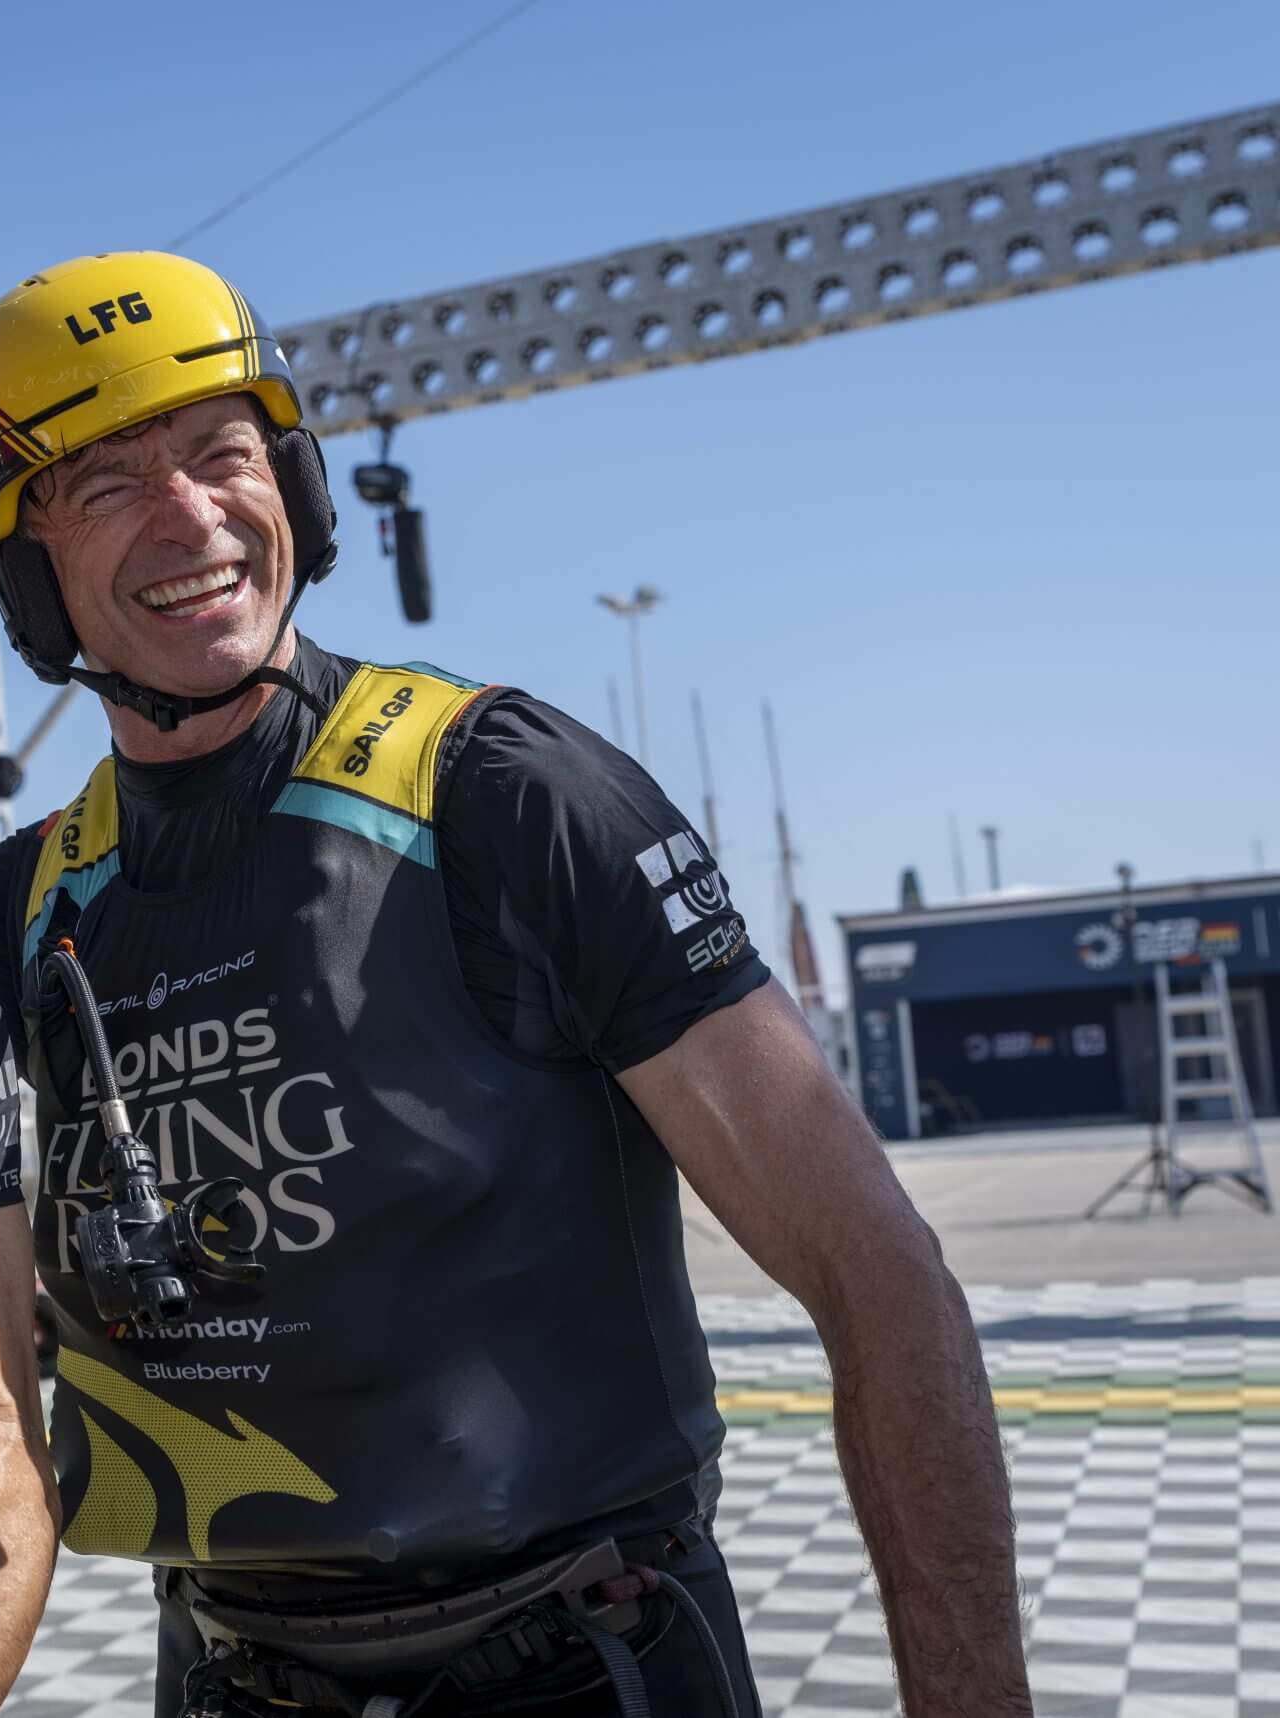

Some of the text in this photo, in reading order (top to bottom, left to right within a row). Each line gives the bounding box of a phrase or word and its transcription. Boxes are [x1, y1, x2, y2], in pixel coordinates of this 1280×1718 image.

[64, 291, 152, 346] LFG
[98, 950, 256, 1016] SAIL RACING
[42, 1072, 356, 1196] FLING
[144, 1362, 271, 1384] Blueberry
